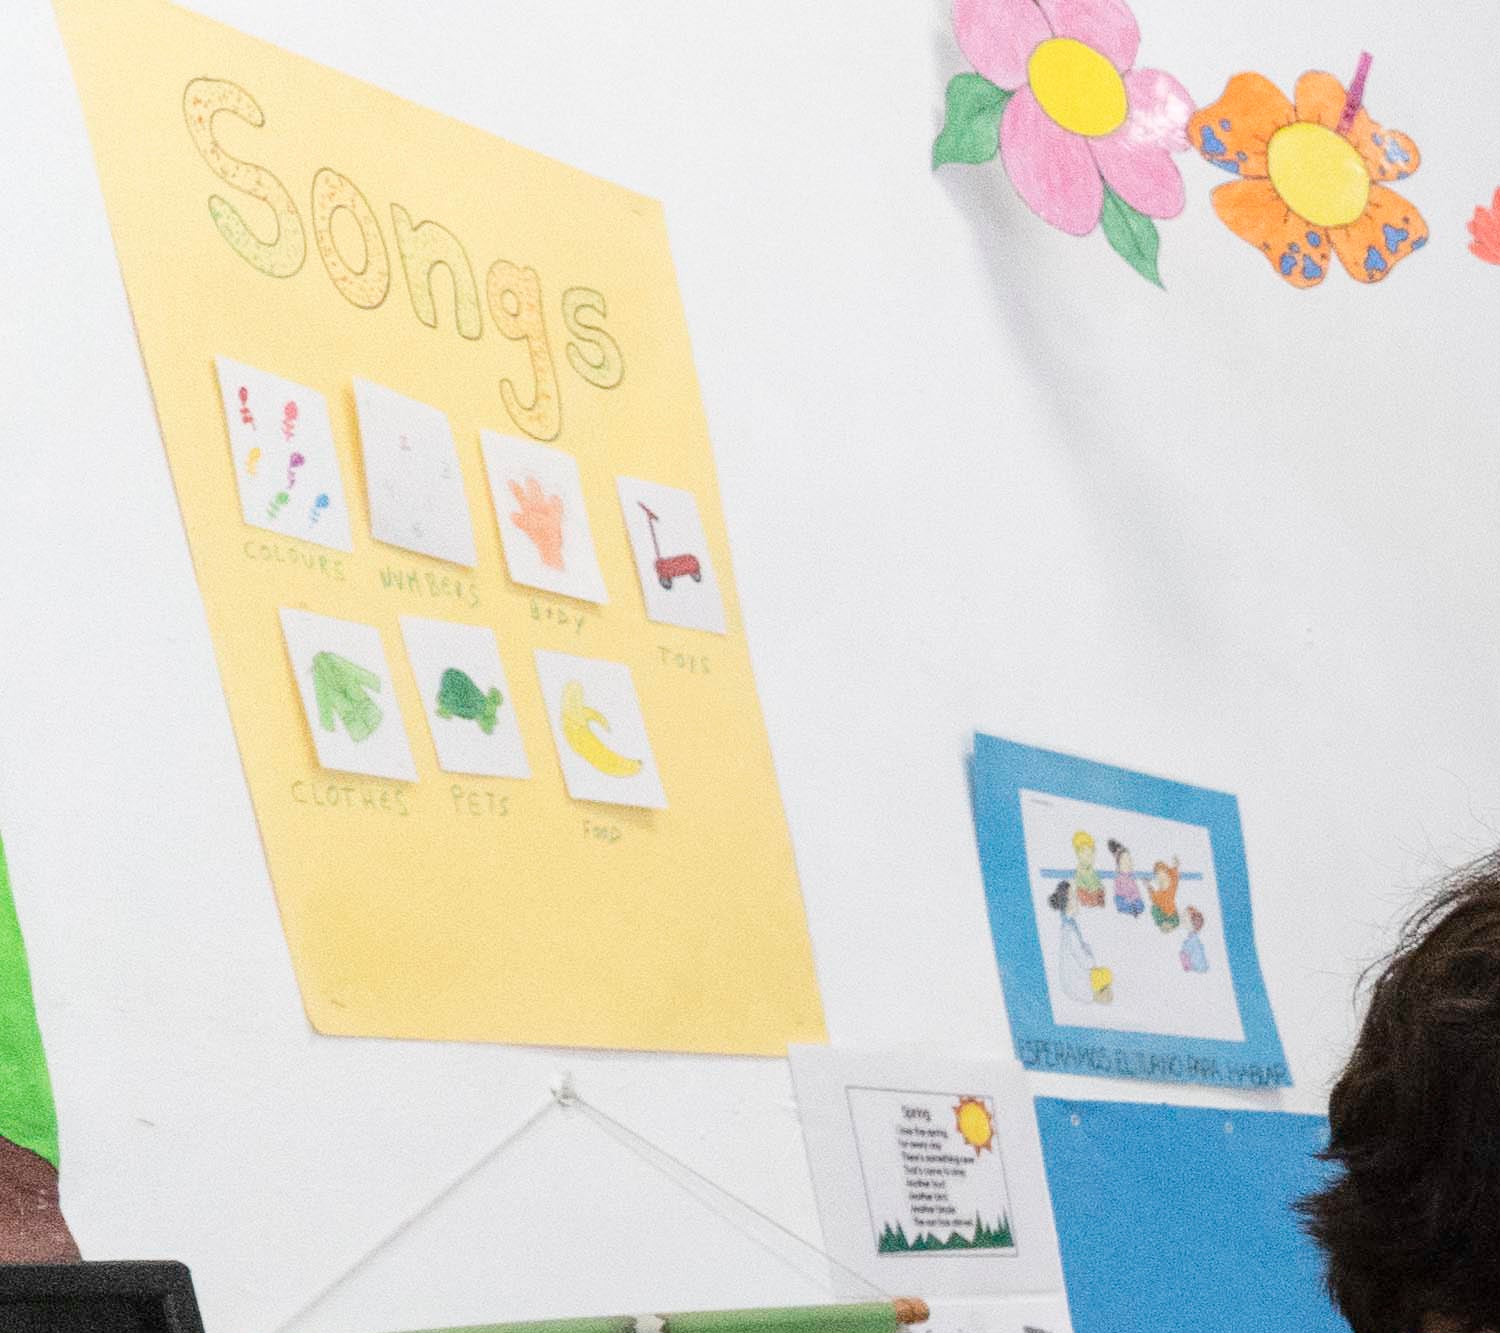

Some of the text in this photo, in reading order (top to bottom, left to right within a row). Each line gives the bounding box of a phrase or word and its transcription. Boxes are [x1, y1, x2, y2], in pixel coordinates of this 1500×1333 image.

[183, 78, 624, 441] Songs
[291, 780, 410, 817] CLOTHES
[450, 784, 510, 817] PETS
